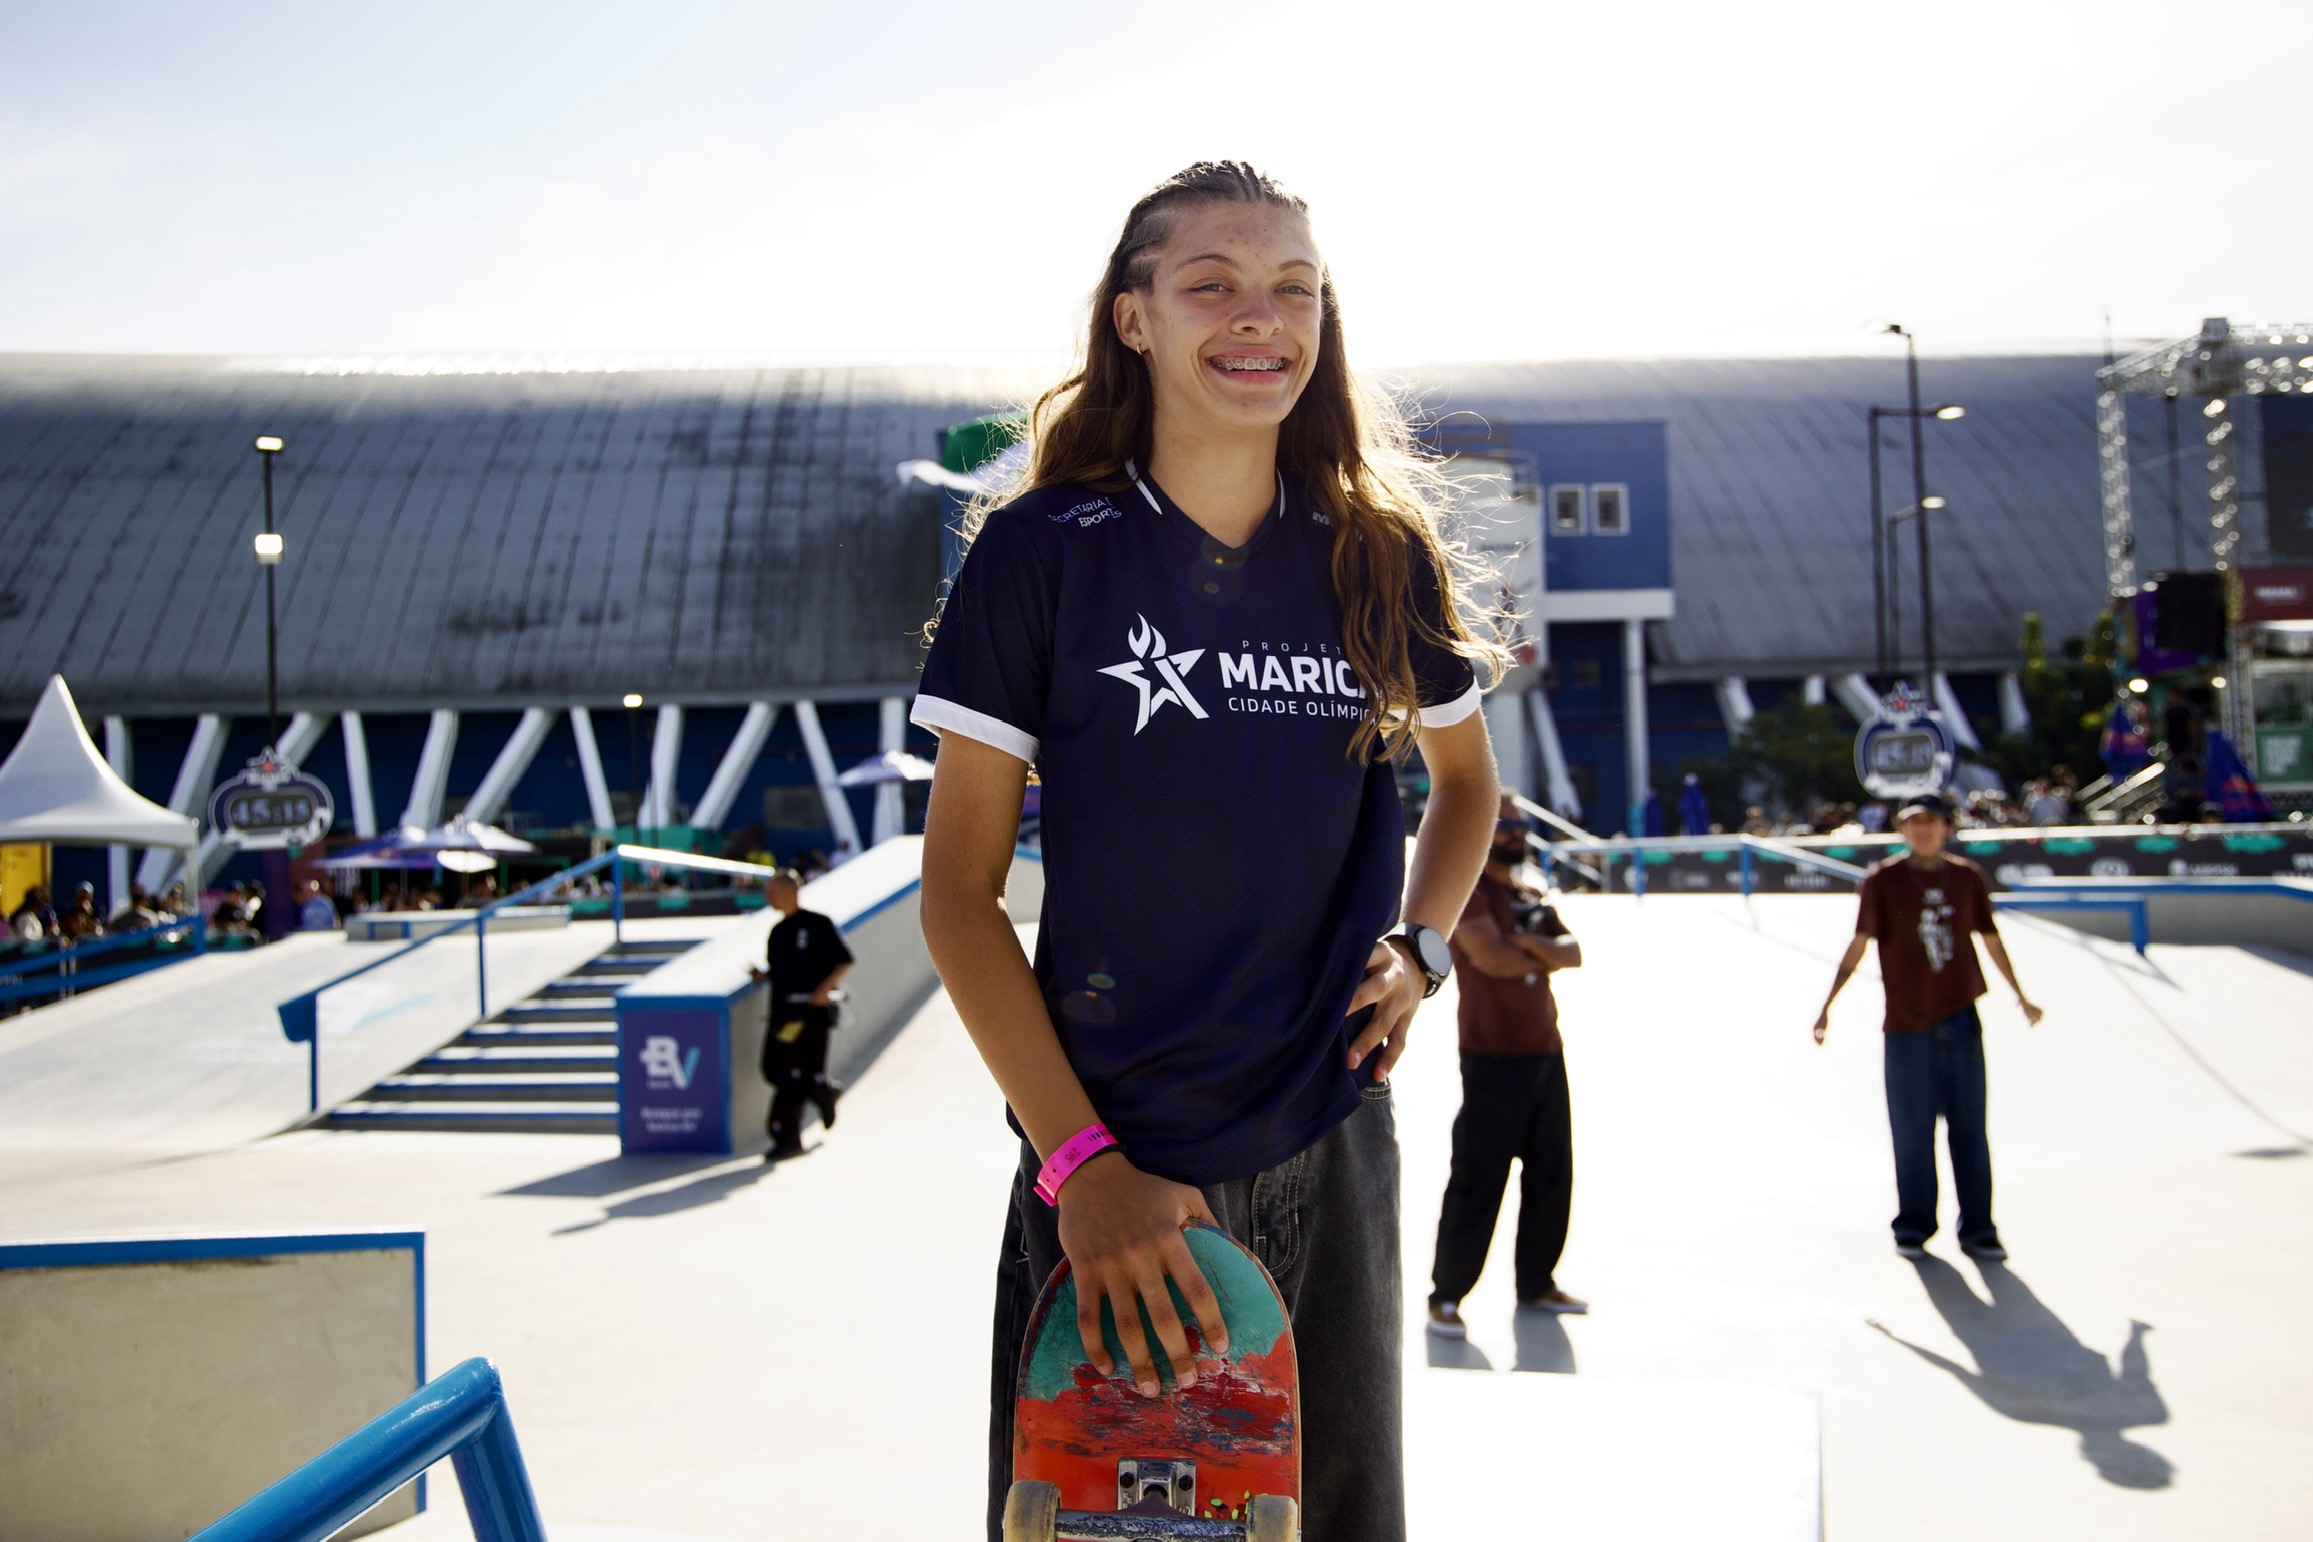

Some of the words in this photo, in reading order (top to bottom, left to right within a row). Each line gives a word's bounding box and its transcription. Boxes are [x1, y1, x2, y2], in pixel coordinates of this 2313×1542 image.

[1047, 499, 1106, 523] CRETARIA
[1242, 640, 1341, 655] PROJET
[1228, 697, 1299, 715] CIDADE
